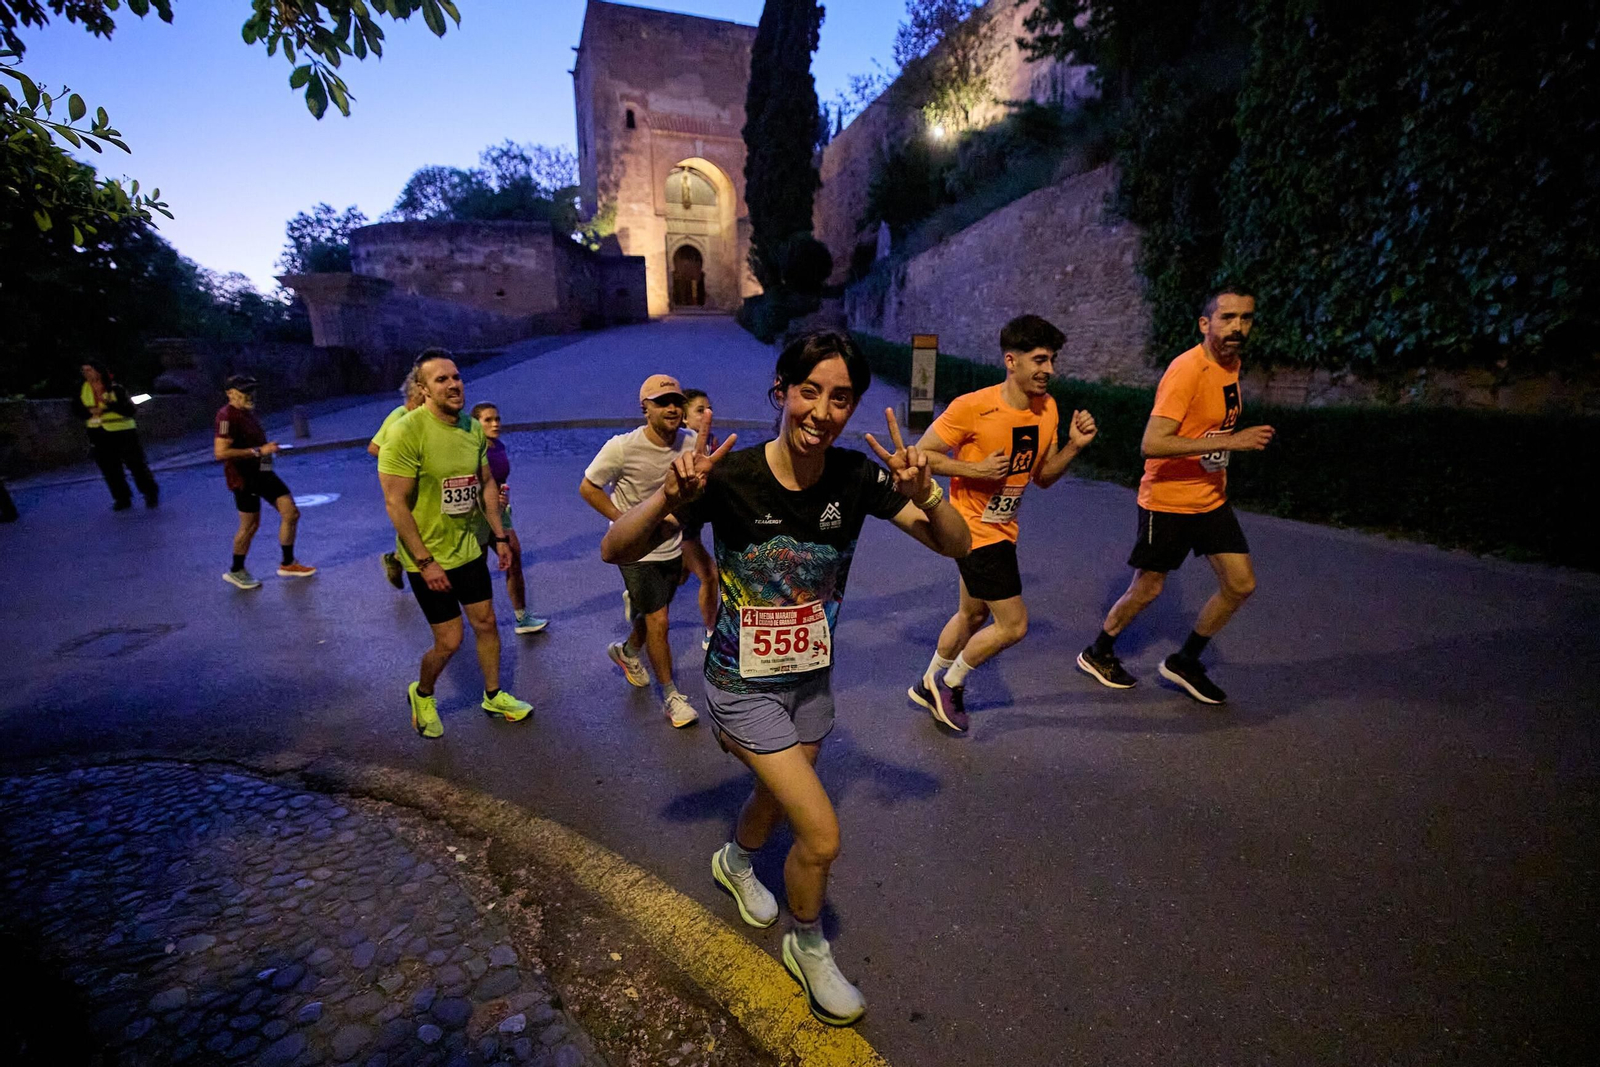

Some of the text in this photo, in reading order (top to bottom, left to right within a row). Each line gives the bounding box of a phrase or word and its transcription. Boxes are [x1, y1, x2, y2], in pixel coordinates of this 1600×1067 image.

[444, 486, 477, 503] 3338
[759, 612, 774, 620] MEDIA
[753, 627, 809, 656] 558
